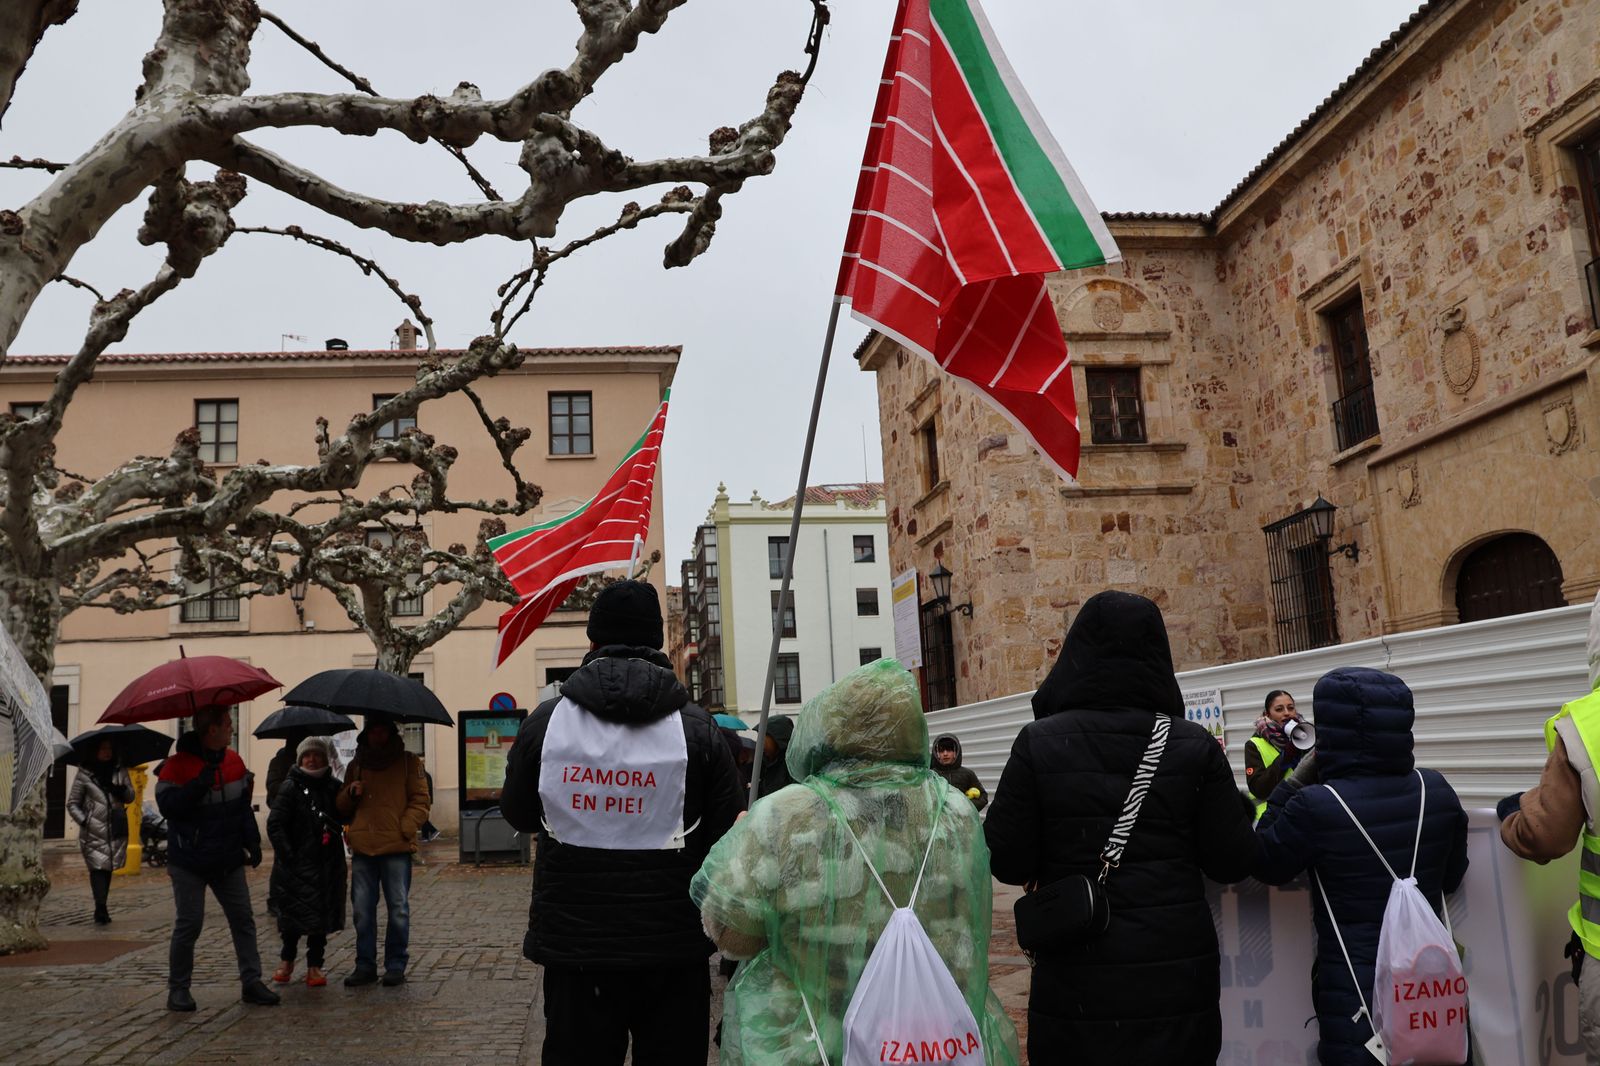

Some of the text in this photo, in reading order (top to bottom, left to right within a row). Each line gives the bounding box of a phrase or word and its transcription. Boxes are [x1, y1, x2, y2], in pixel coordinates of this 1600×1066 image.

[563, 766, 657, 788] ¡ZAMORA
[572, 793, 643, 814] EN PIE!
[1394, 976, 1468, 1002] ¡ZAMO
[1409, 1006, 1468, 1030] EN PI
